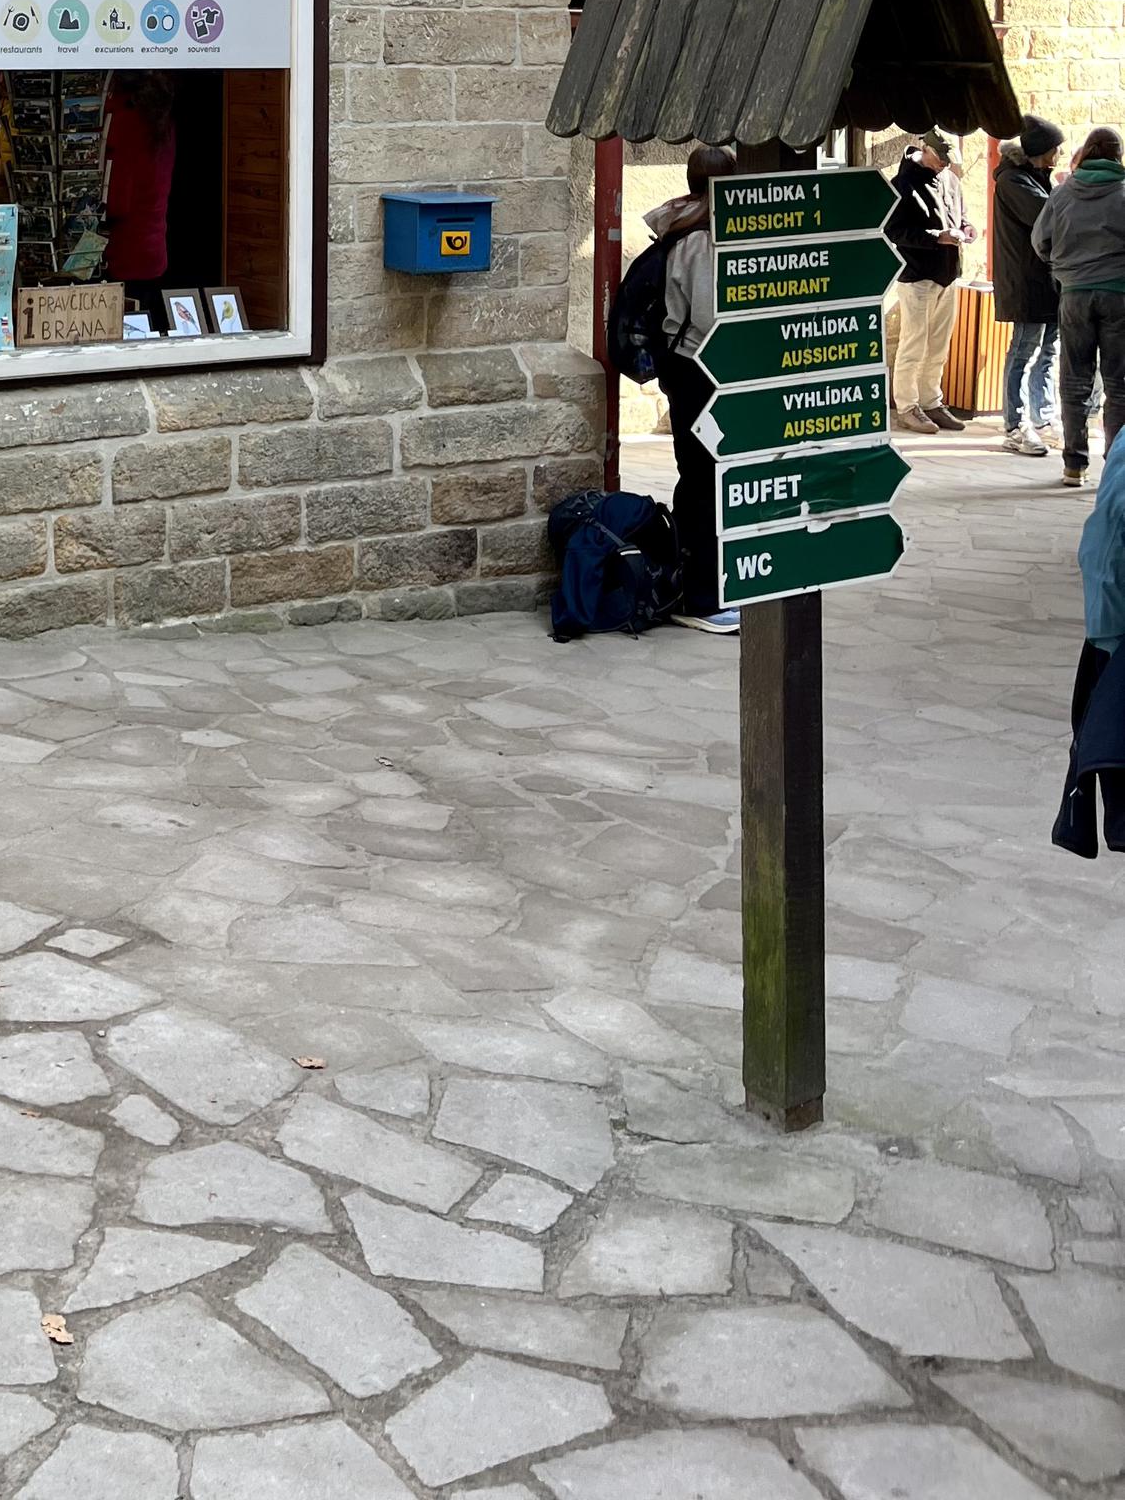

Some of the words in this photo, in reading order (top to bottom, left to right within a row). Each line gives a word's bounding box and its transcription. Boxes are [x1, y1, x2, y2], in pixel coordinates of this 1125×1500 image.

[0, 45, 43, 54] restaurants
[57, 45, 79, 54] travel
[94, 45, 134, 54] excursions
[140, 45, 179, 55] exchange
[187, 45, 221, 54] souvenirs
[725, 182, 806, 206] VYHLÍDKA
[812, 183, 821, 200] 1
[726, 211, 805, 234] AUSSICHT
[813, 210, 822, 226] 1
[726, 250, 830, 276] RESTAURACE
[726, 277, 831, 303] RESTAURANT
[781, 316, 859, 341] VYHLÍDKA
[868, 313, 878, 330] 2
[781, 342, 859, 369] AUSSICHT
[869, 341, 879, 357] 2
[783, 385, 864, 411] VYHLÍDKA
[871, 383, 880, 399] 3
[783, 412, 863, 439] AUSSICHT
[871, 411, 881, 427] 3
[728, 474, 803, 508] BUFET
[736, 551, 774, 581] WC
